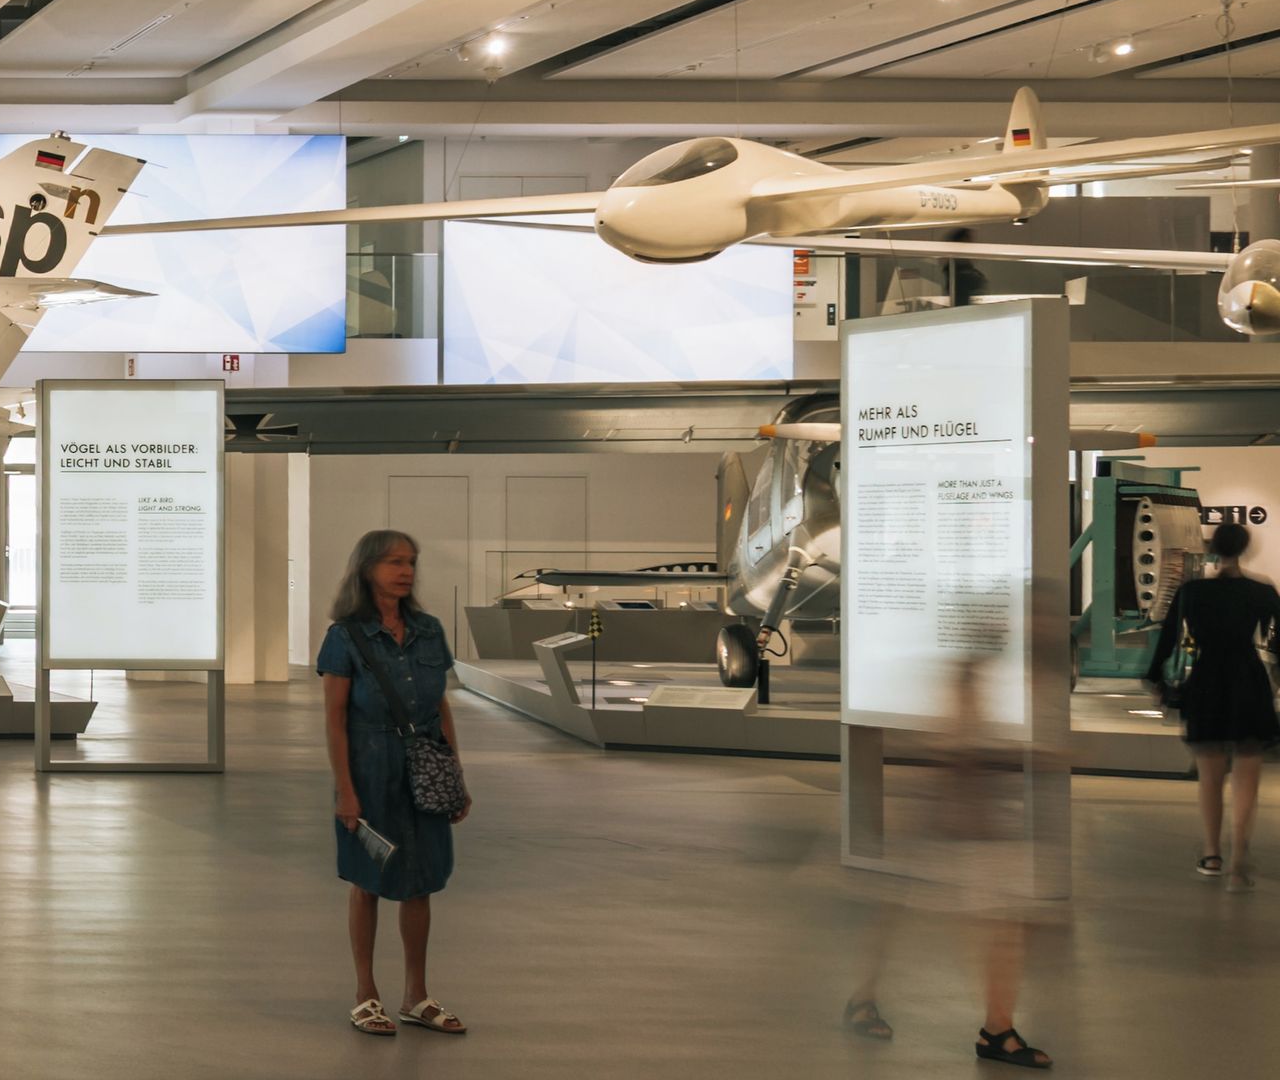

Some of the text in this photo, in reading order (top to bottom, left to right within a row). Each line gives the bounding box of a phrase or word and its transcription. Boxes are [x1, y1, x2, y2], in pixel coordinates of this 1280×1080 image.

[858, 404, 918, 421] MEHR ALS
[858, 419, 979, 442] RUMPF UND FLÜGEL
[60, 441, 198, 454] VÖGEL ALS VORBILDER:
[60, 457, 172, 468] LEICHT UND STABIL
[960, 480, 977, 488] THAN
